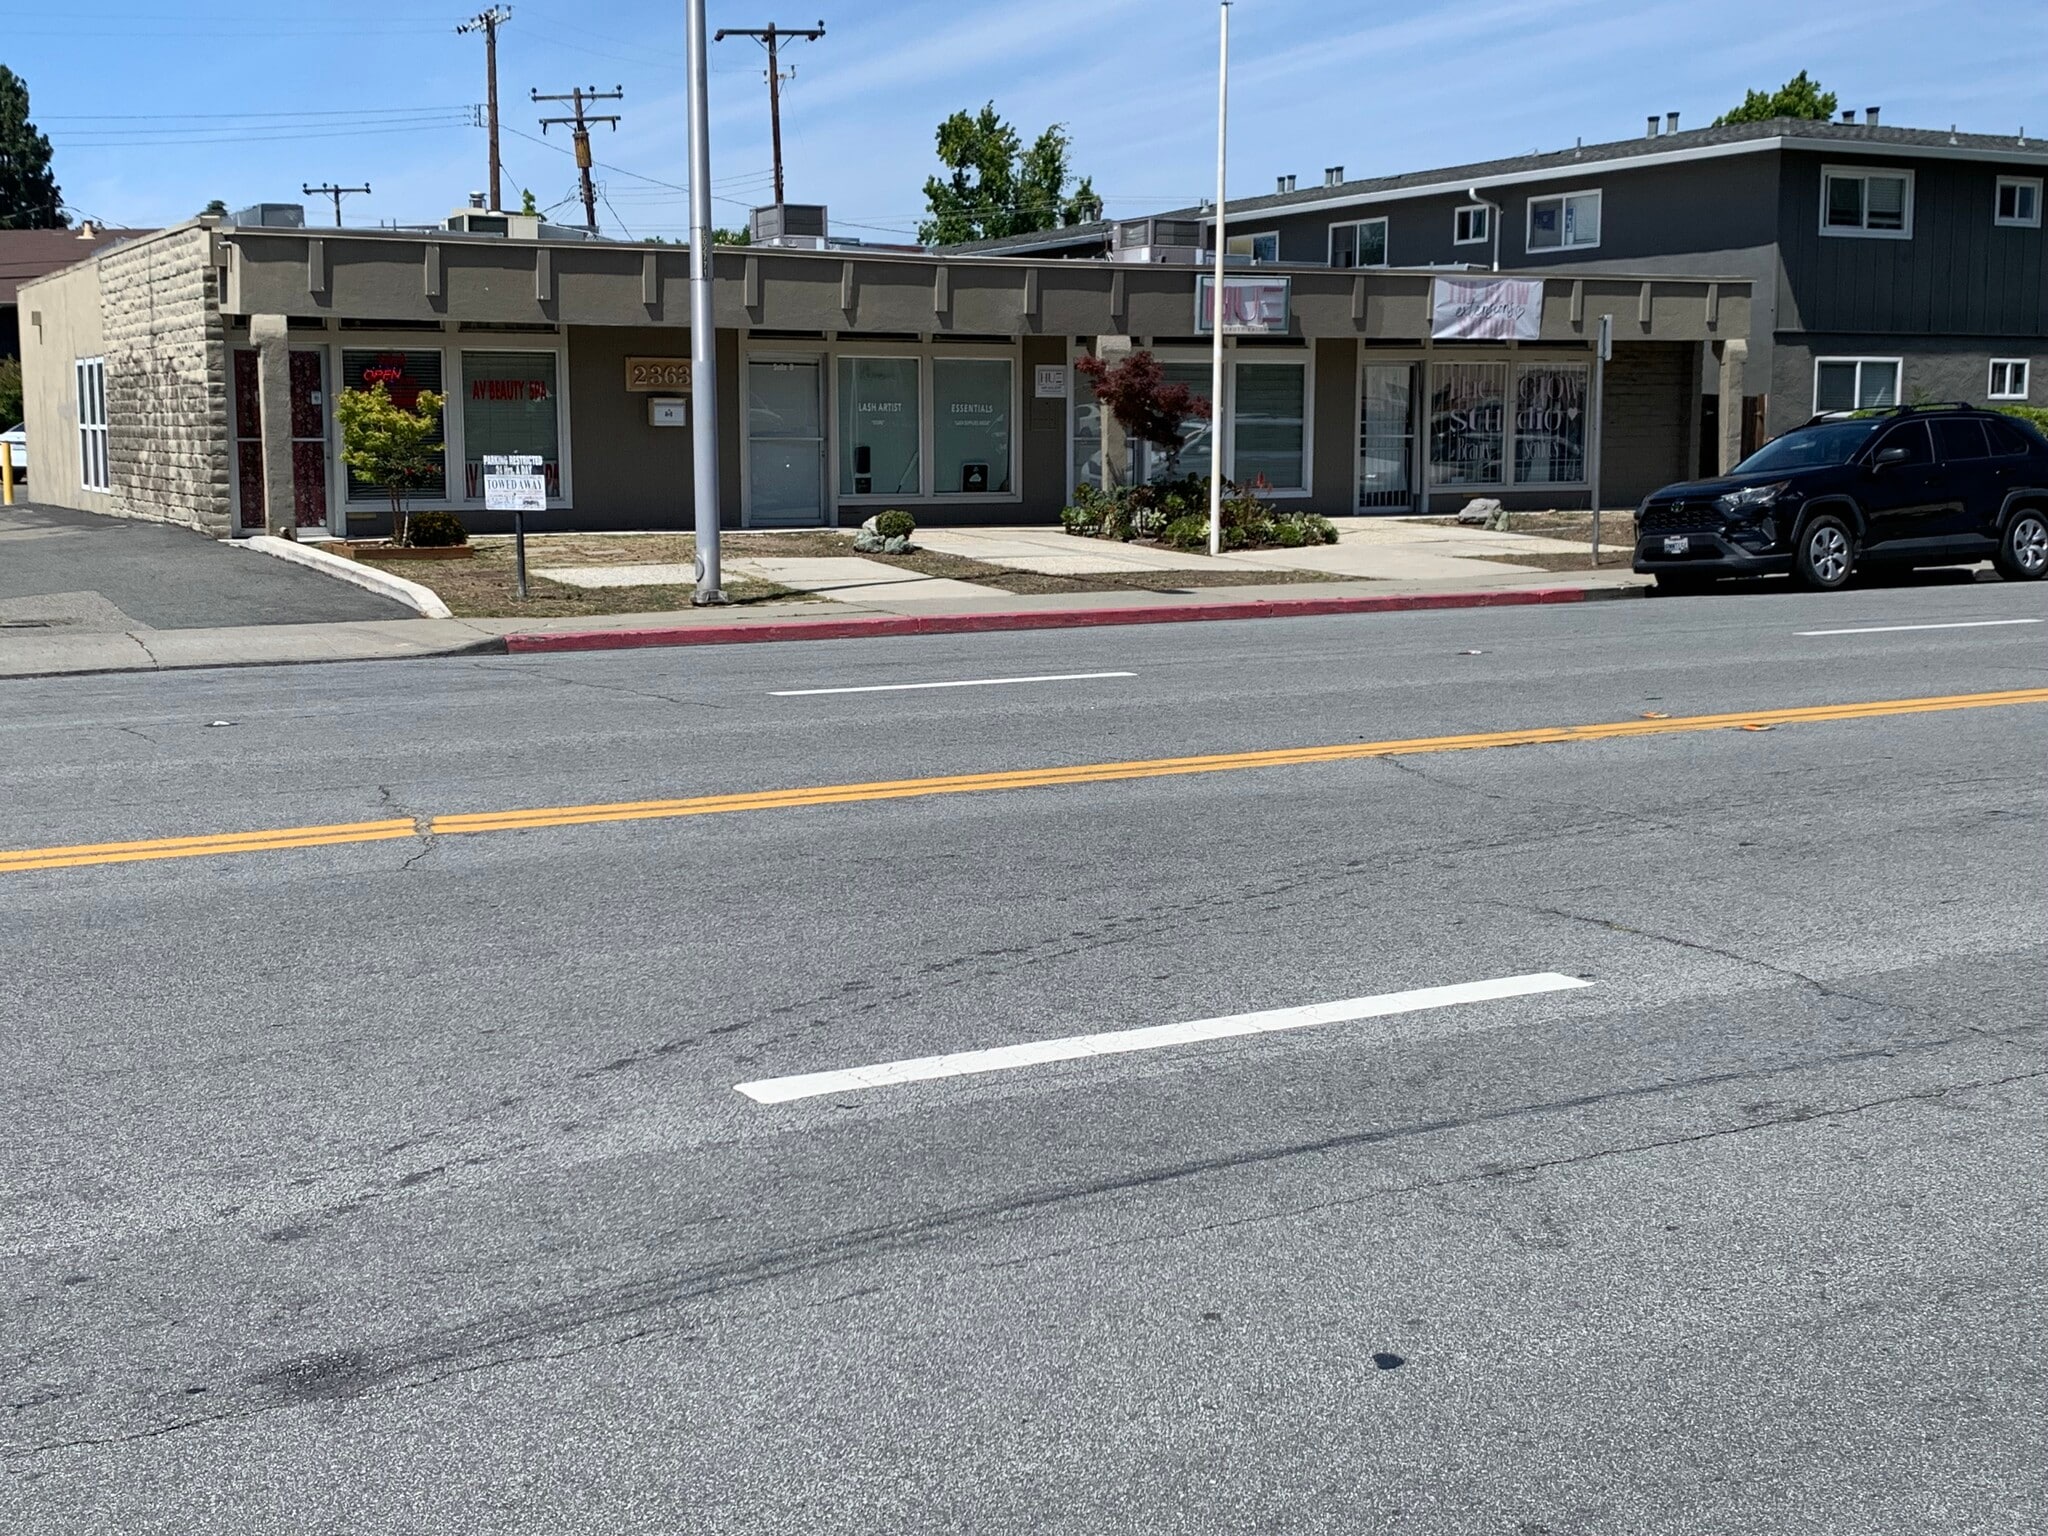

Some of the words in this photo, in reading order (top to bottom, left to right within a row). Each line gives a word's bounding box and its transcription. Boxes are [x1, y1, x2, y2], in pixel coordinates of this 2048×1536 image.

[1207, 286, 1284, 323] HUE
[363, 368, 402, 382] OPEN
[633, 365, 691, 385] 2363
[489, 380, 524, 400] BEAUTY
[527, 380, 548, 400] SPA
[858, 403, 877, 412] LASH
[878, 403, 902, 412] ARTIST
[951, 404, 993, 413] ESSENTIALS
[483, 455, 508, 465] PARKING
[509, 455, 543, 466] RESTRICTED
[487, 479, 517, 490] TOWED
[520, 479, 542, 490] AWAY
